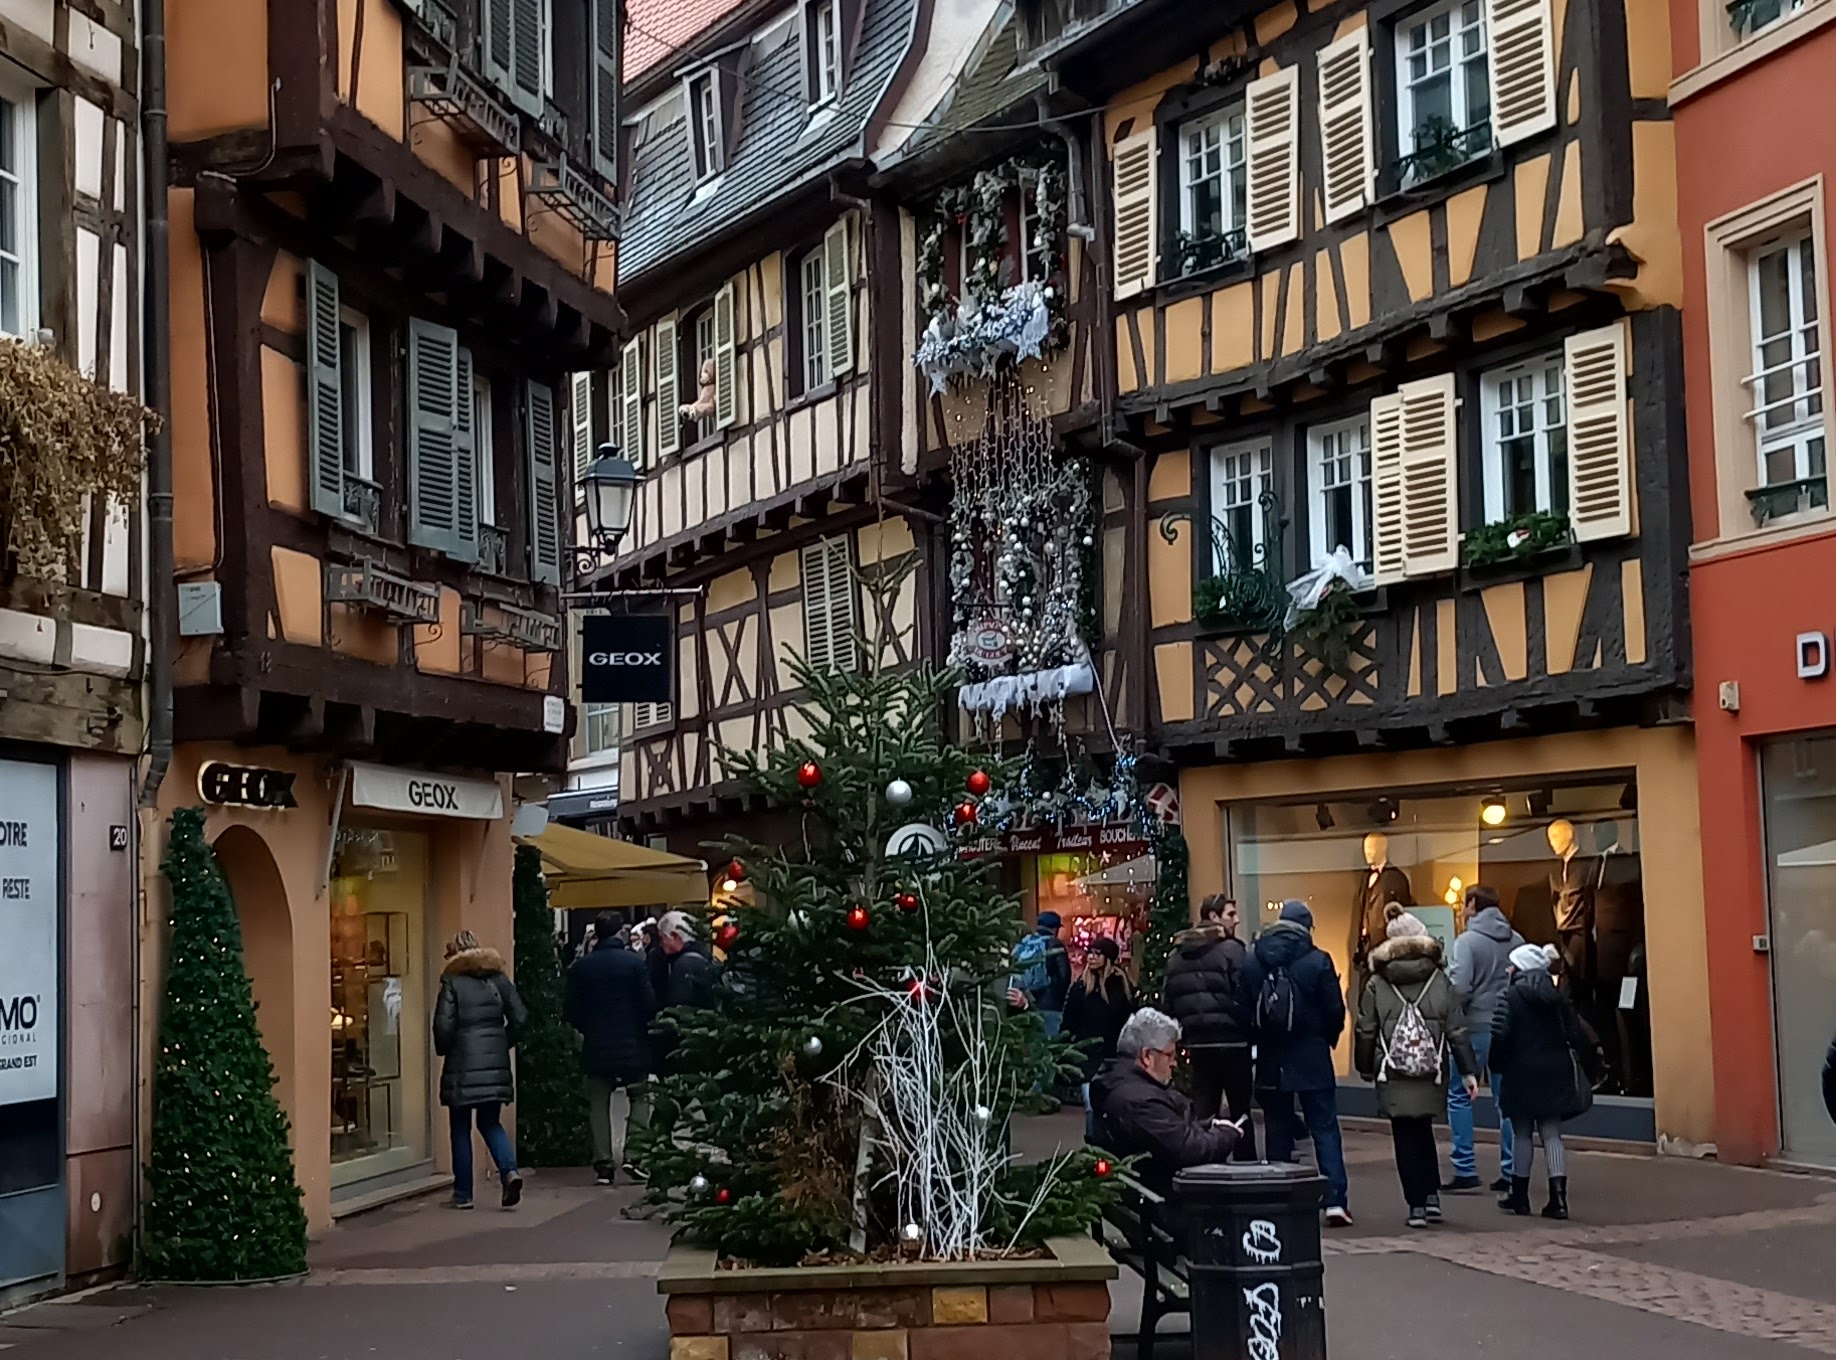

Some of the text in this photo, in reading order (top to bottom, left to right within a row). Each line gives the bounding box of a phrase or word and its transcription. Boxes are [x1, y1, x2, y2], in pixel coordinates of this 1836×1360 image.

[588, 652, 662, 666] GEOX
[408, 780, 459, 811] GEOX
[113, 827, 128, 846] 20
[3, 878, 30, 900] RESTE
[24, 1054, 38, 1068] EST
